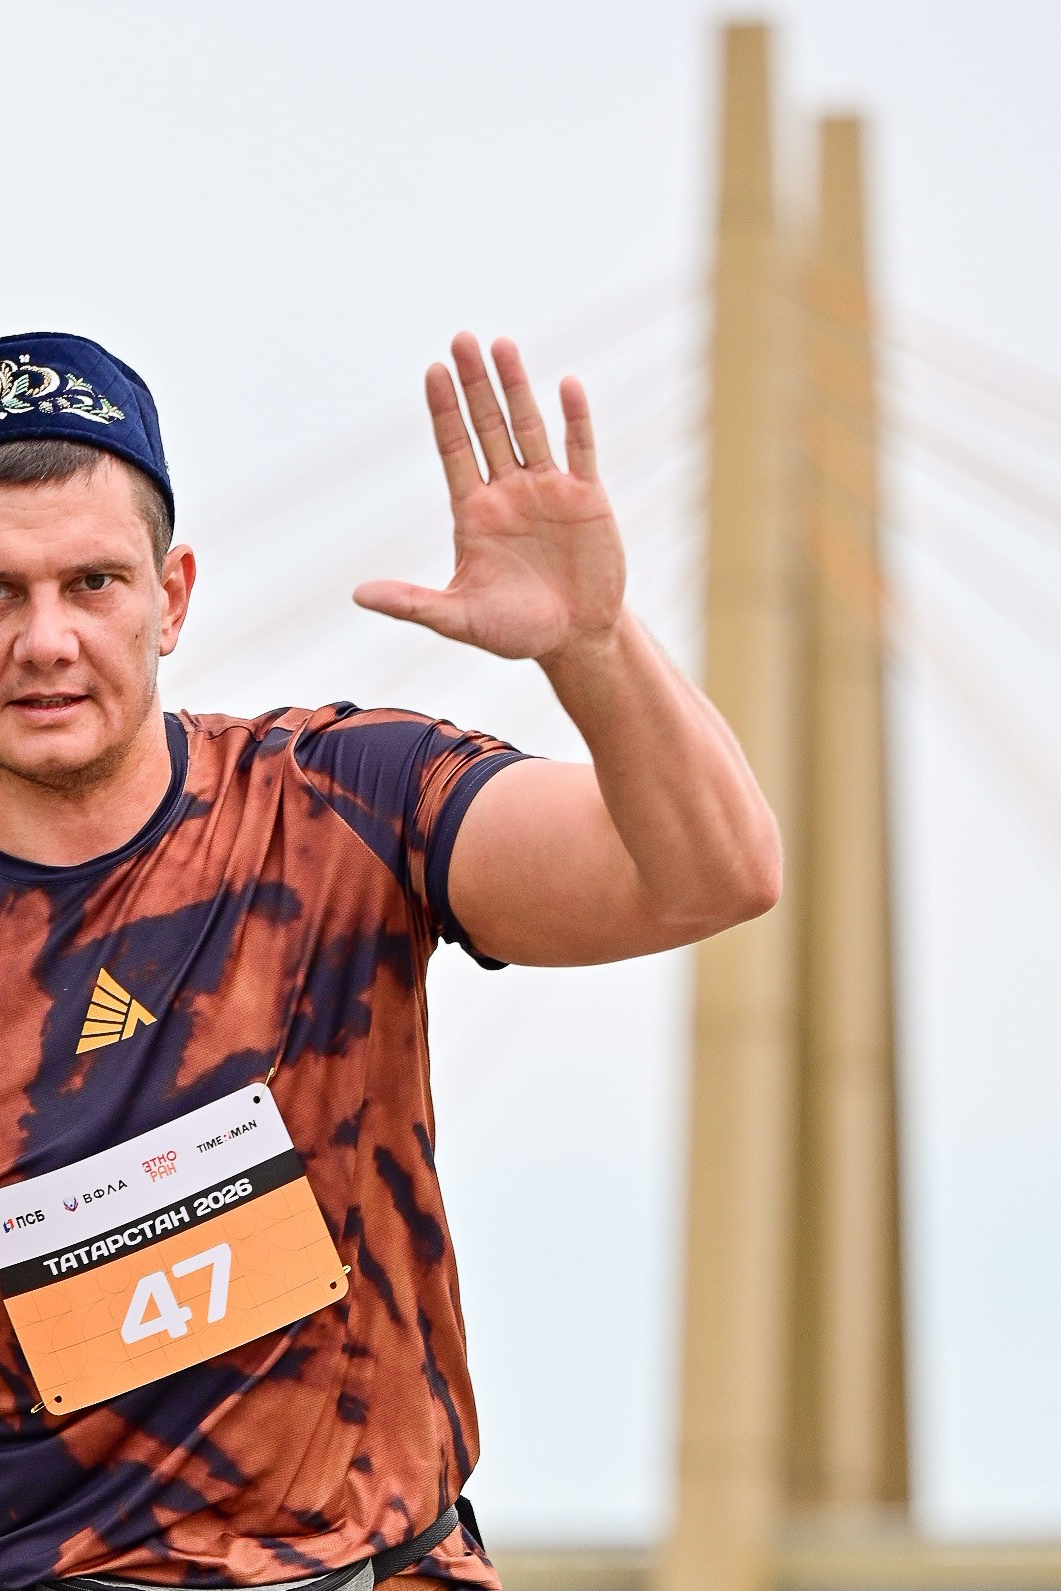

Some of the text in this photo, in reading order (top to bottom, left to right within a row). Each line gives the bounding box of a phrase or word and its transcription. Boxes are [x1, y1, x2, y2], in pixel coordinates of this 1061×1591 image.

[15, 1209, 46, 1229] ПСБ
[82, 1179, 128, 1204] ВФЛА
[43, 1178, 253, 1276] ТАТАРСТАН 2026
[120, 1242, 232, 1345] 47
